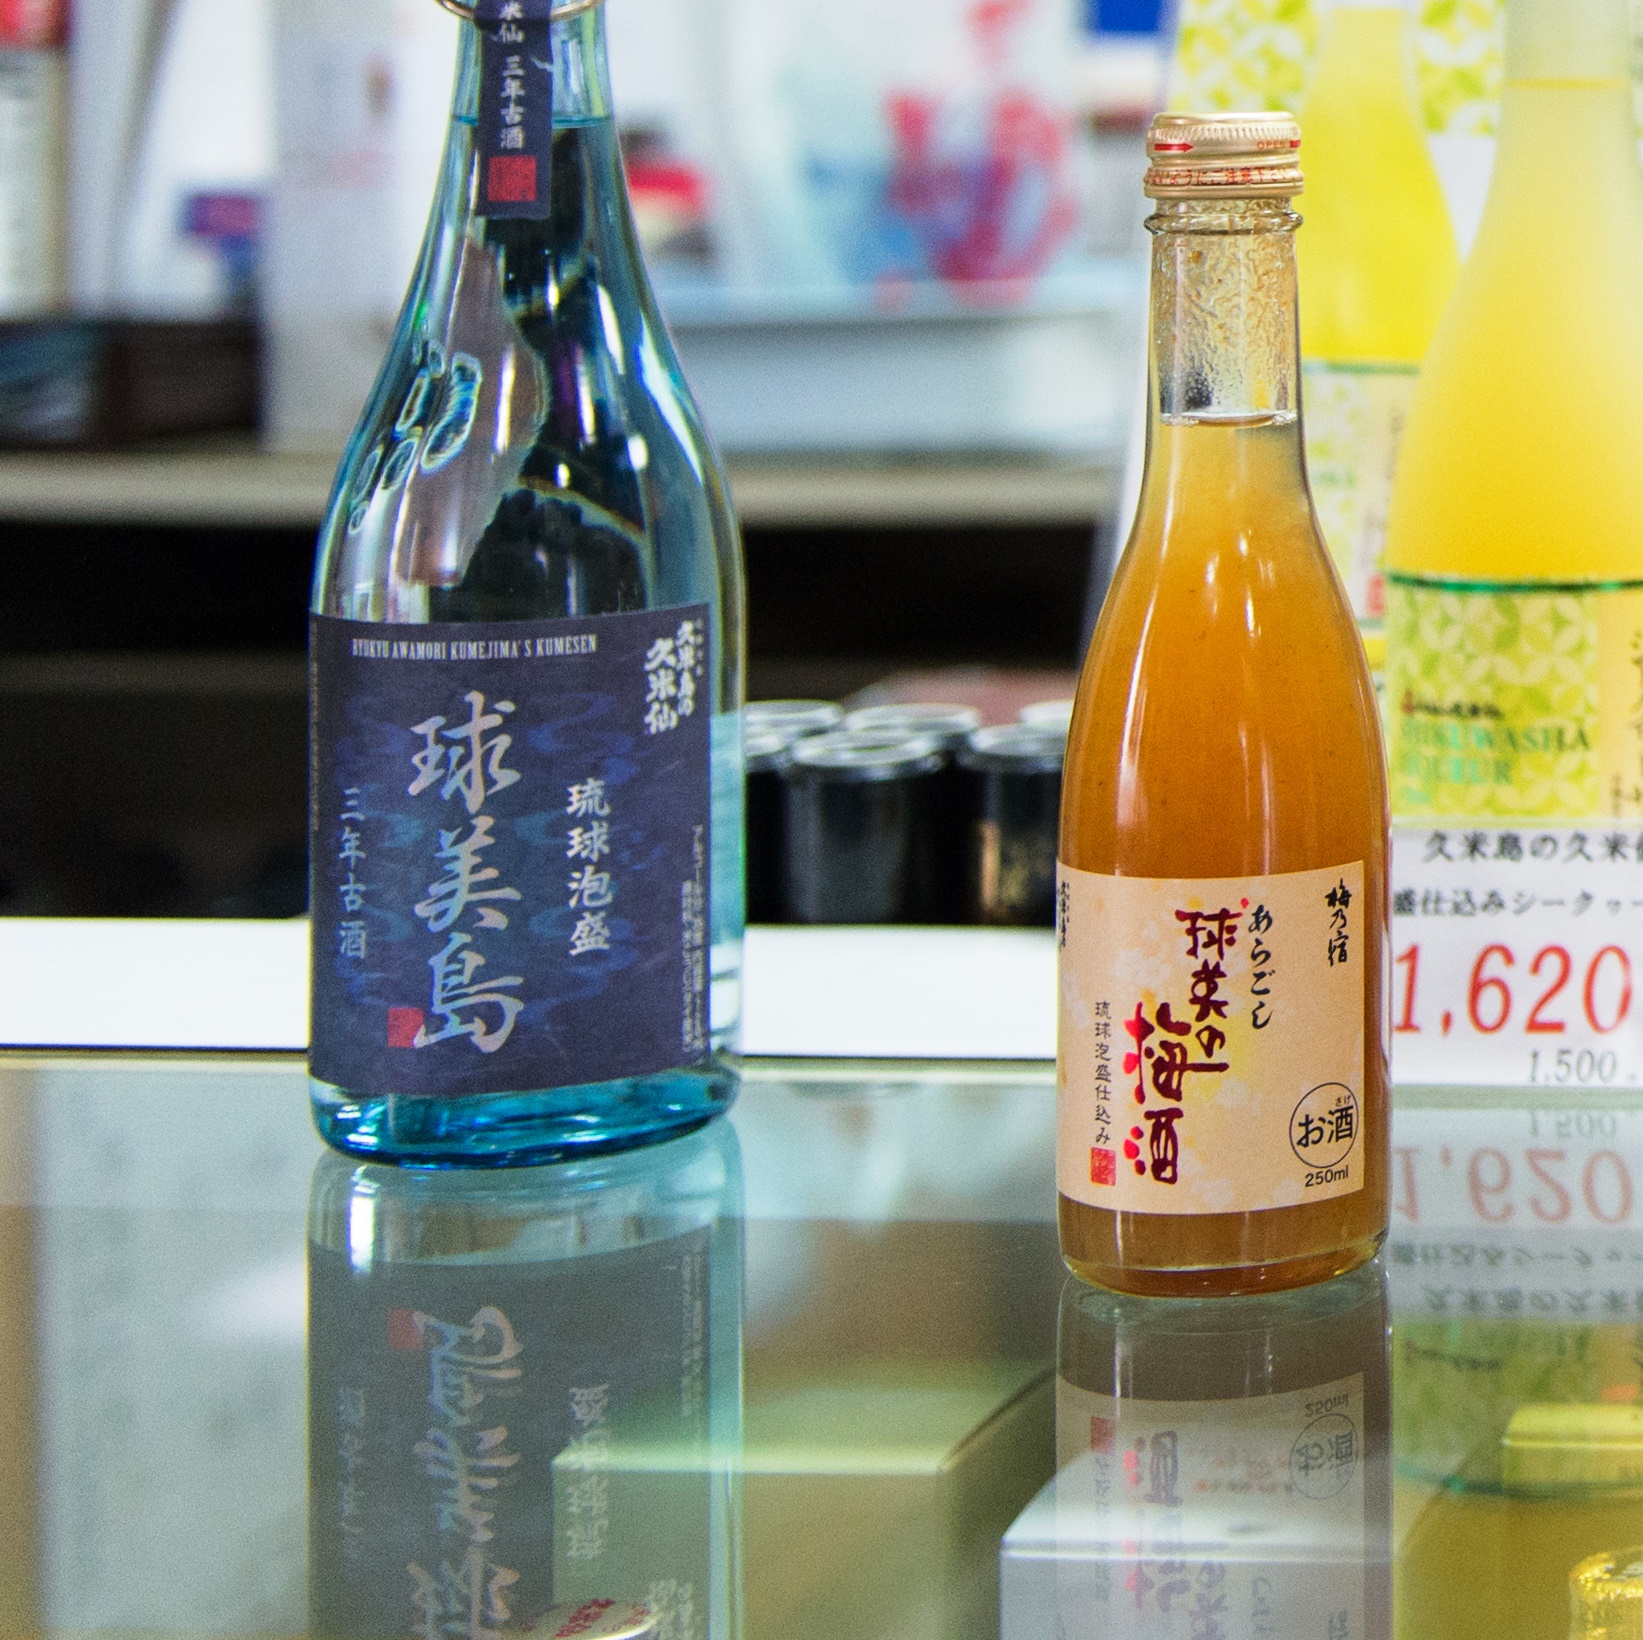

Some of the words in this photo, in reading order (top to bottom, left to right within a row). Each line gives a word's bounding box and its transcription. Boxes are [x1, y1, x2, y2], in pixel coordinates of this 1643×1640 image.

[501, 54, 526, 150] 三年古酒
[1257, 139, 1286, 150] OPEN
[392, 640, 447, 660] AWAMORI
[536, 634, 597, 658] KUMESEN
[644, 636, 679, 736] 久米仙
[339, 786, 367, 960] 三年古酒
[408, 690, 525, 1053] 球美島
[566, 777, 613, 957] 琉球泡盛
[1247, 904, 1276, 1031] あらごし
[1325, 877, 1352, 967] 梅乃宿
[1175, 898, 1249, 1059] 球美の
[1393, 942, 1634, 1037] 1,620
[1094, 1000, 1113, 1145] 琉球泡盛仕込み
[1122, 1001, 1230, 1186] 梅酒
[1335, 1095, 1351, 1107] さけ
[1296, 1104, 1355, 1149] お酒
[1304, 1165, 1350, 1188] 250ml
